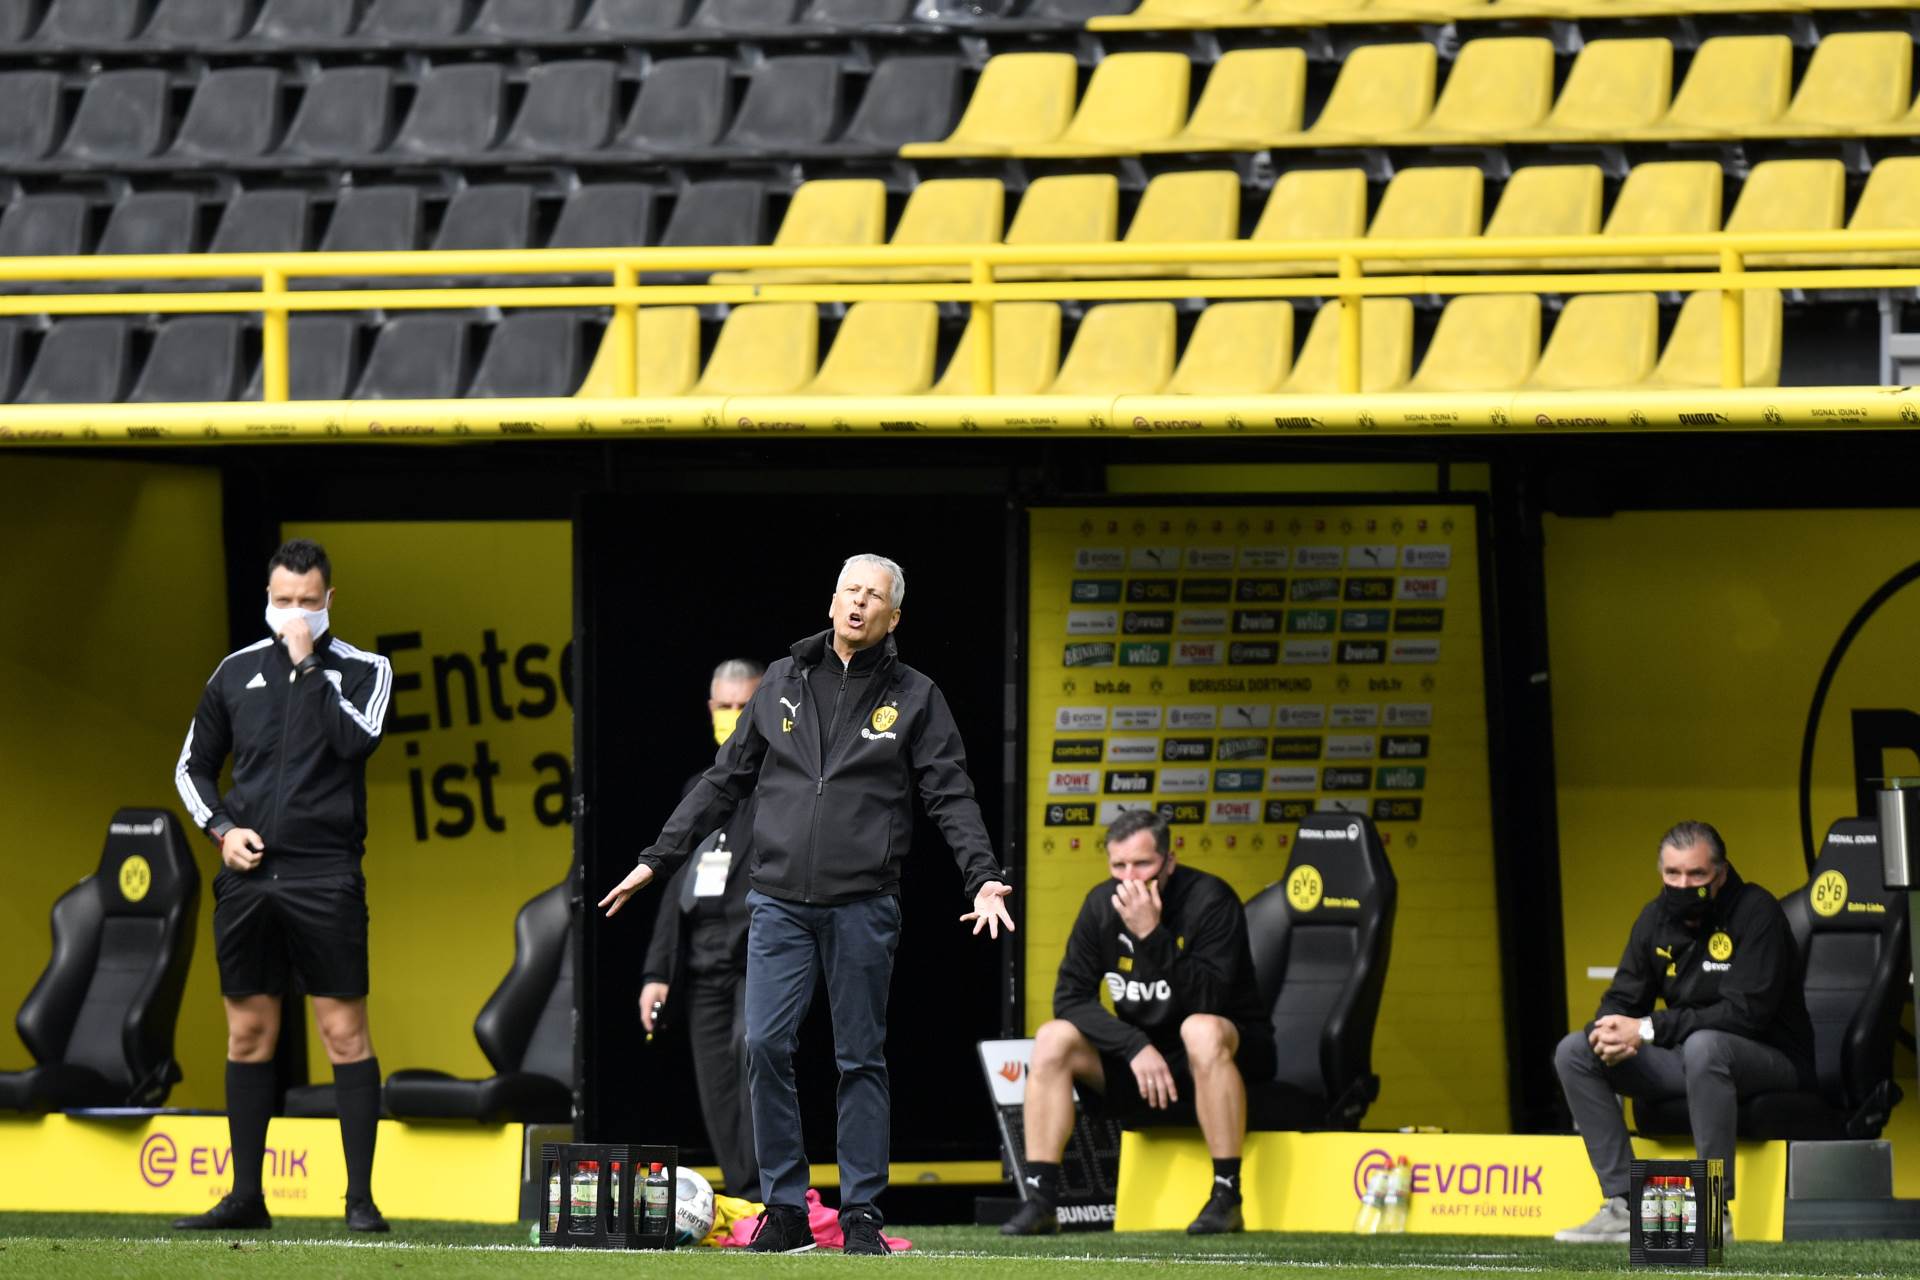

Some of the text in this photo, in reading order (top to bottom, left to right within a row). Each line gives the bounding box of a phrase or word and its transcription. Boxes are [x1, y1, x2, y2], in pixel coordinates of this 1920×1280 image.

[1128, 643, 1160, 663] wilo
[1345, 644, 1378, 660] bwin
[1094, 680, 1131, 694] bvb.de
[1189, 677, 1312, 693] BORUSSIA DORTMUND
[1369, 677, 1403, 692] bvb.tv
[1387, 739, 1421, 755] bwin
[1056, 773, 1091, 786] ROWE
[1111, 774, 1147, 792] bwin
[1385, 769, 1416, 787] wilo
[405, 740, 505, 842] ist
[1065, 807, 1089, 821] OPEL
[1175, 807, 1199, 820] OPEL
[1216, 803, 1251, 816] ROWE
[1828, 834, 1877, 844] SIGNAL IDUNA
[1293, 871, 1318, 896] BVB
[1816, 876, 1842, 901] BVB
[191, 1147, 308, 1177] EVNIK
[1411, 1163, 1543, 1195] EVONIK
[1431, 1203, 1542, 1217] KRAFT FÜR NEUES
